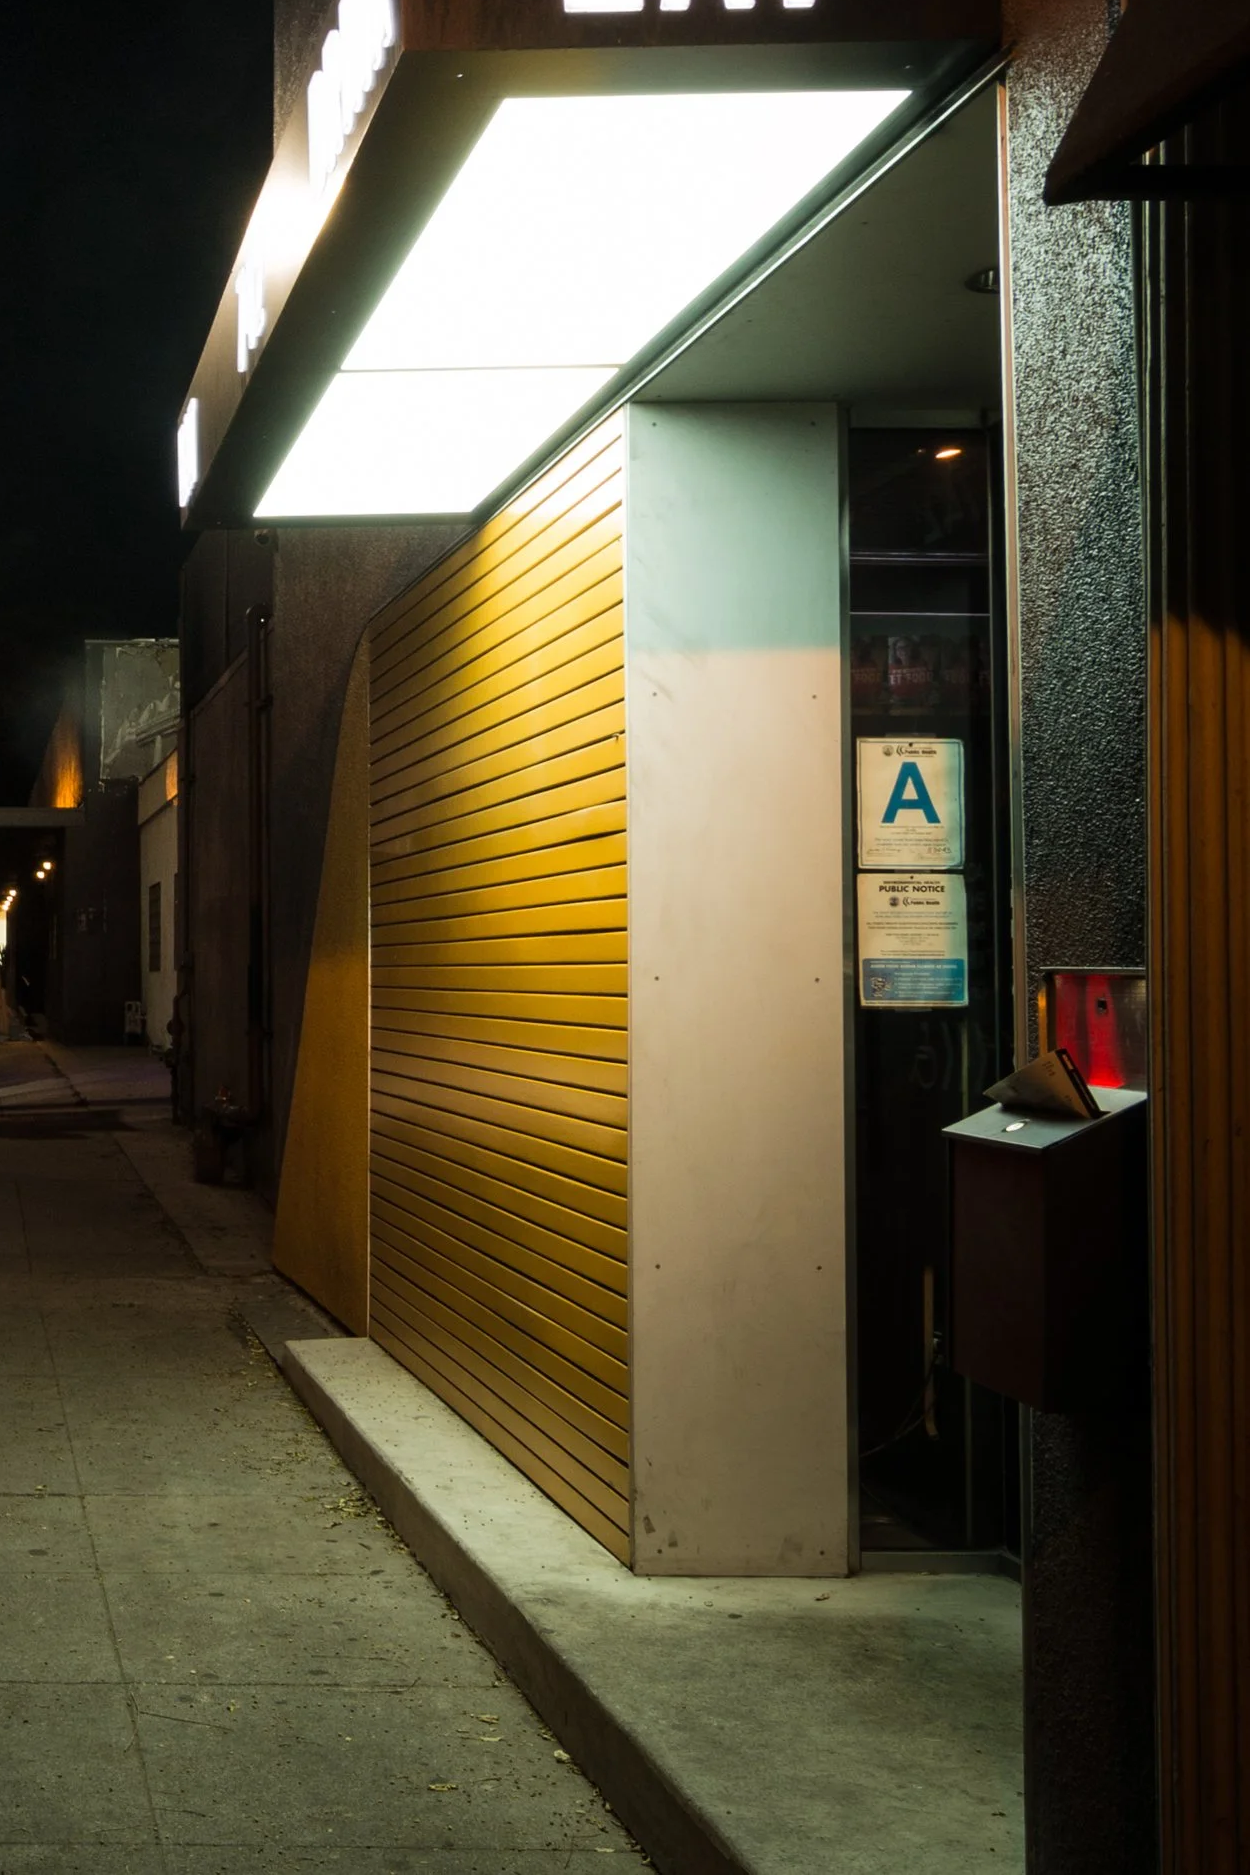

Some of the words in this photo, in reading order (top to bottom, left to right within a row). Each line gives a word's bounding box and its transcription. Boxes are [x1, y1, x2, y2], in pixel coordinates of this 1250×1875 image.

[881, 761, 942, 824] A
[879, 885, 909, 893] PUBLIC
[912, 885, 945, 893] NOTICE
